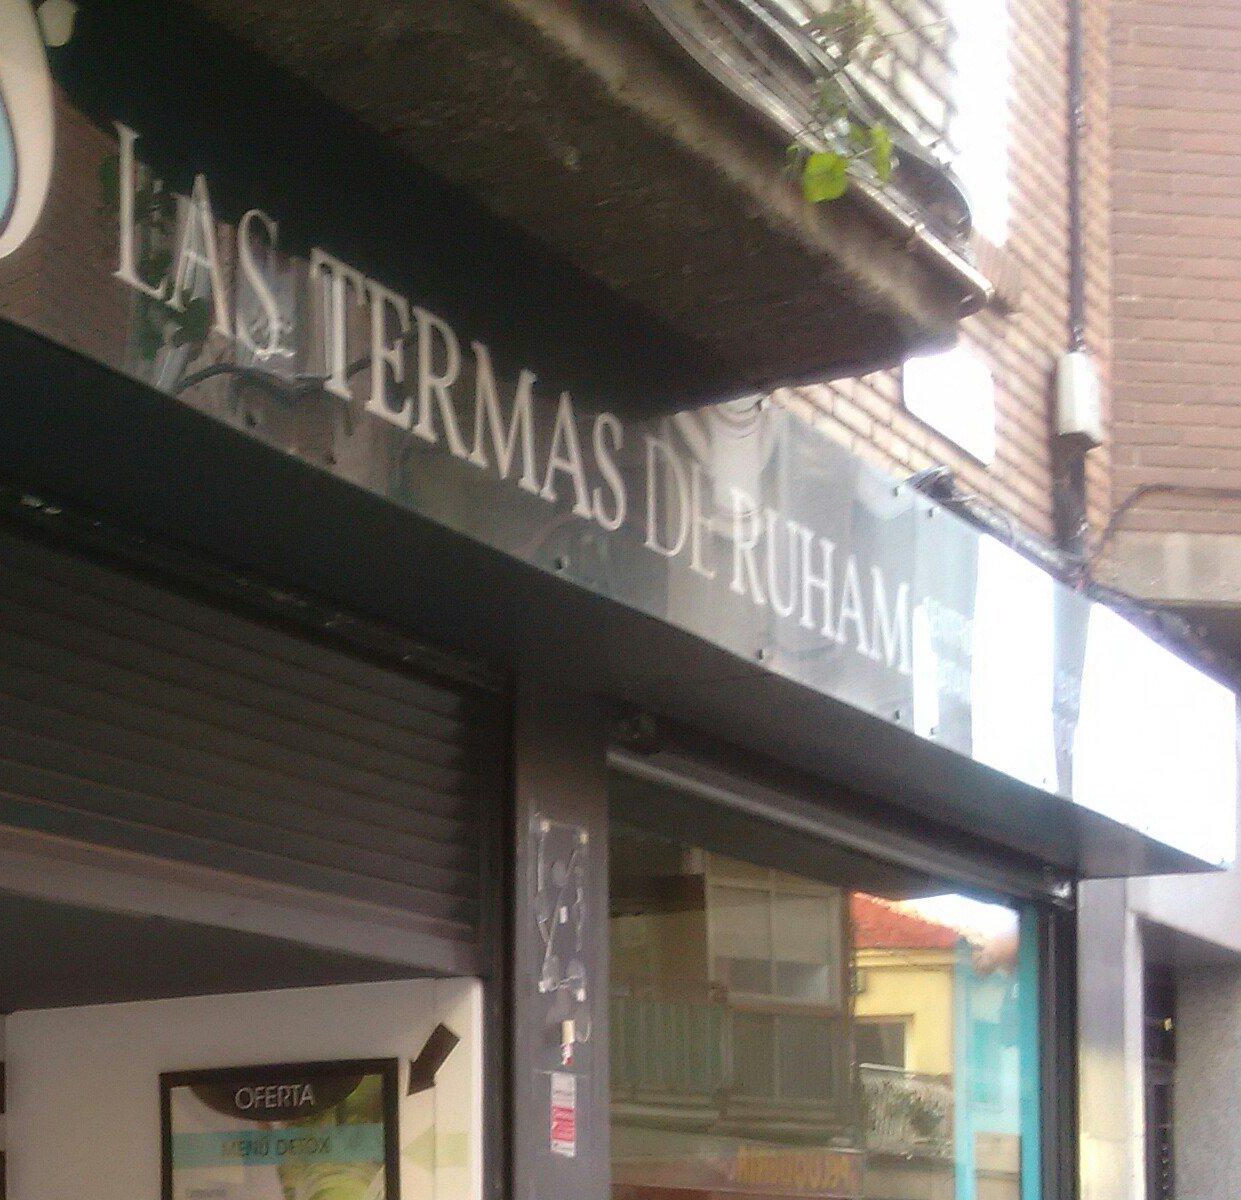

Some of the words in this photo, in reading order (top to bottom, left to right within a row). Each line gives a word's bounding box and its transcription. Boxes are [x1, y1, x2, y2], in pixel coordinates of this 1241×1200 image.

[113, 120, 279, 356] LAS
[310, 247, 626, 530] TERMAS
[730, 489, 912, 674] RUHAM
[235, 1084, 316, 1110] OFERTA
